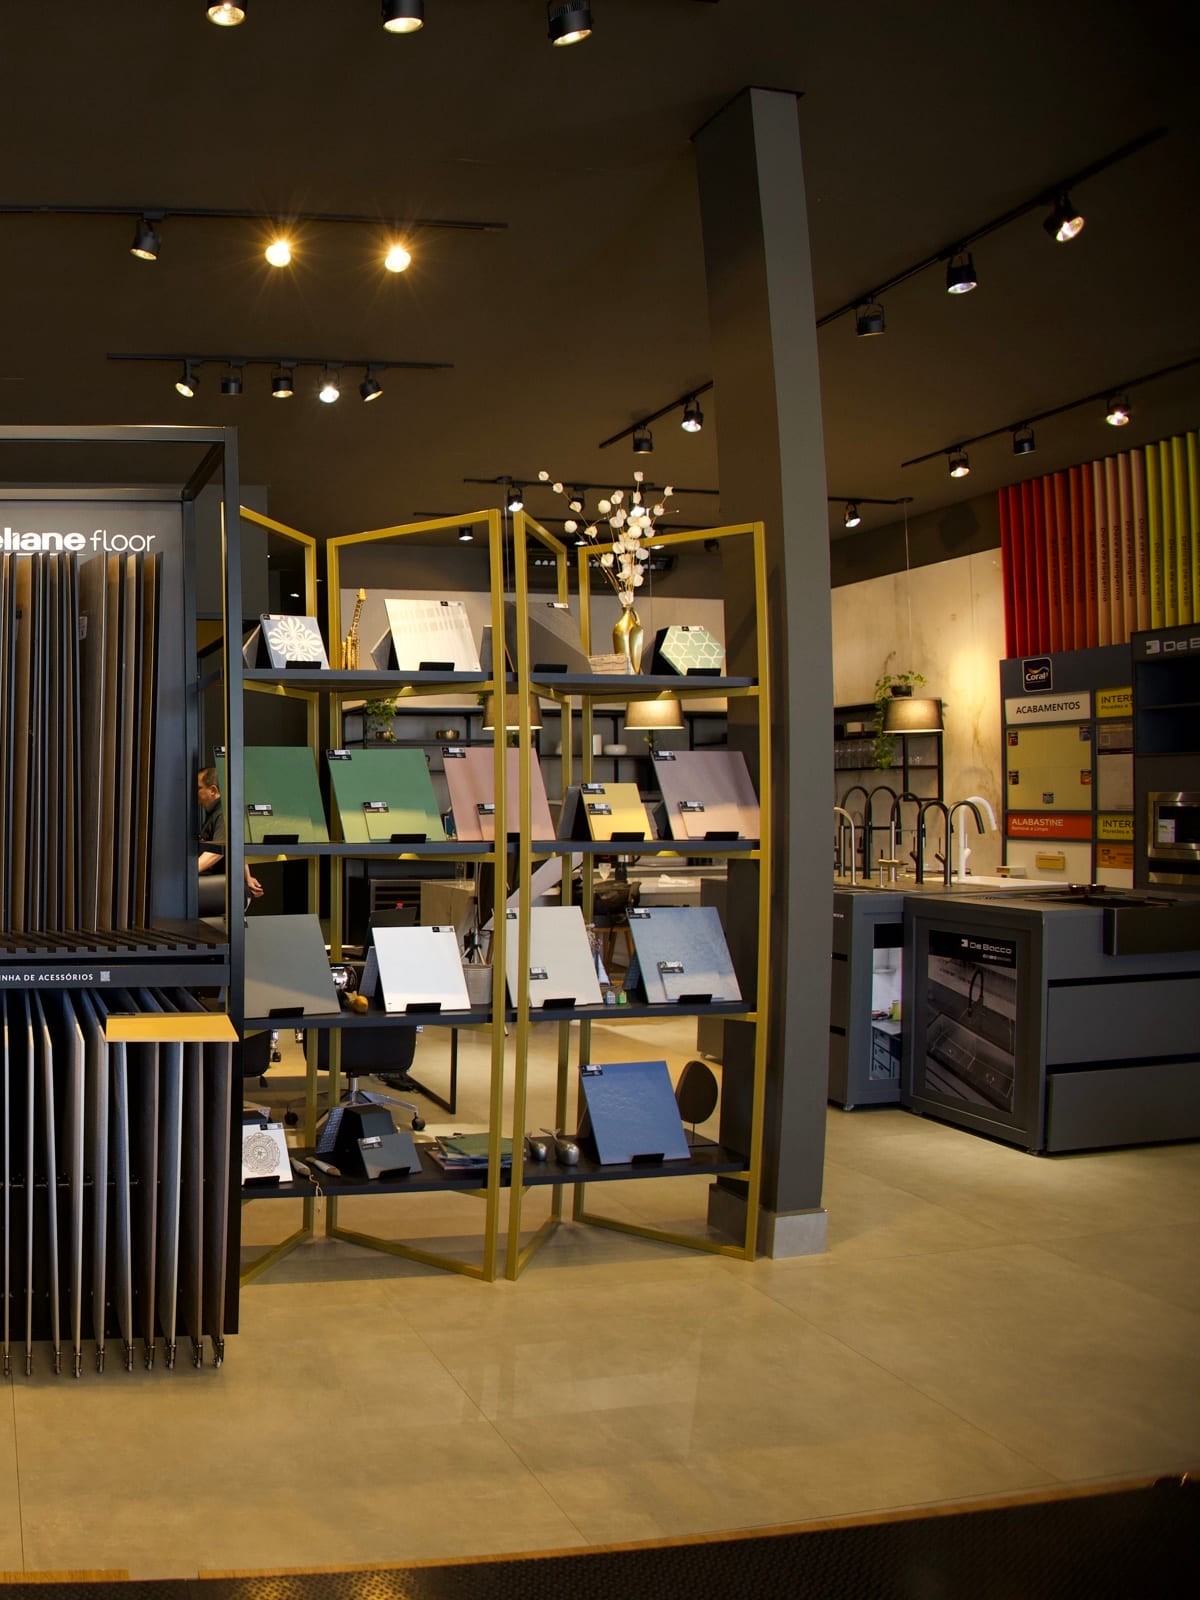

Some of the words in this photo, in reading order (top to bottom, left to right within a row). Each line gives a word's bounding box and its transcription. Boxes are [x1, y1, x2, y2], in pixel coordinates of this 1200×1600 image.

[90, 529, 156, 552] floor
[1025, 671, 1046, 681] Coral
[1101, 694, 1133, 705] INTER
[1016, 701, 1080, 714] ACABAMENTOS
[1011, 818, 1064, 827] ALABASTINE
[1102, 819, 1134, 828] INTER
[38, 972, 94, 981] ACESSÓRIOS
